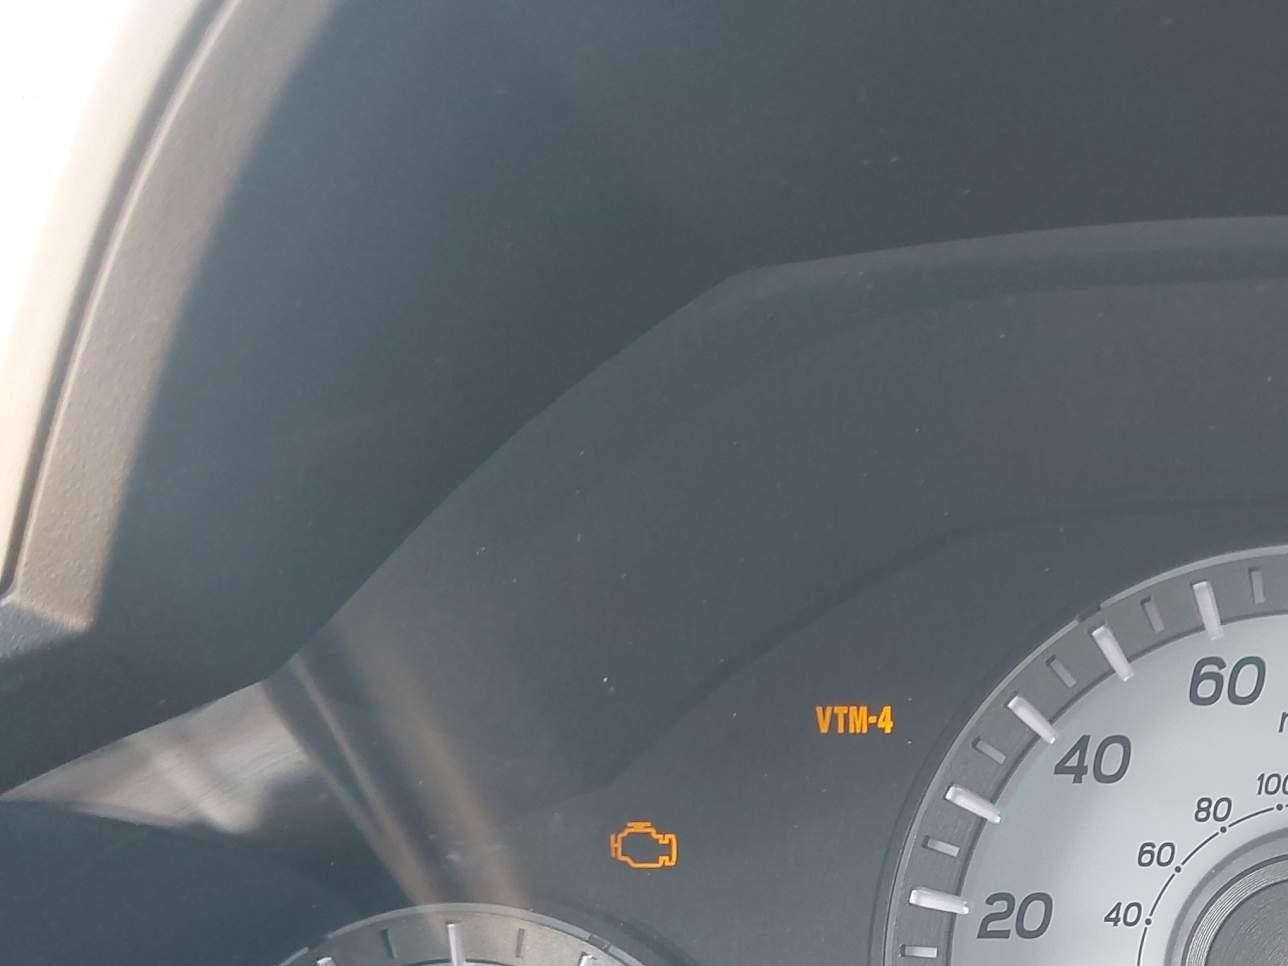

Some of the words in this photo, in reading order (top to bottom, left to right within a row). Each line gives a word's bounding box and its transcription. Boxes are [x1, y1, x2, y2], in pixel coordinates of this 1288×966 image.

[1188, 656, 1266, 706] 60
[816, 705, 894, 734] VTM-4
[1053, 734, 1132, 784] 40
[1194, 797, 1233, 823] 80
[1137, 843, 1176, 867] 60
[976, 892, 1053, 940] 20
[1103, 902, 1142, 927] 40
